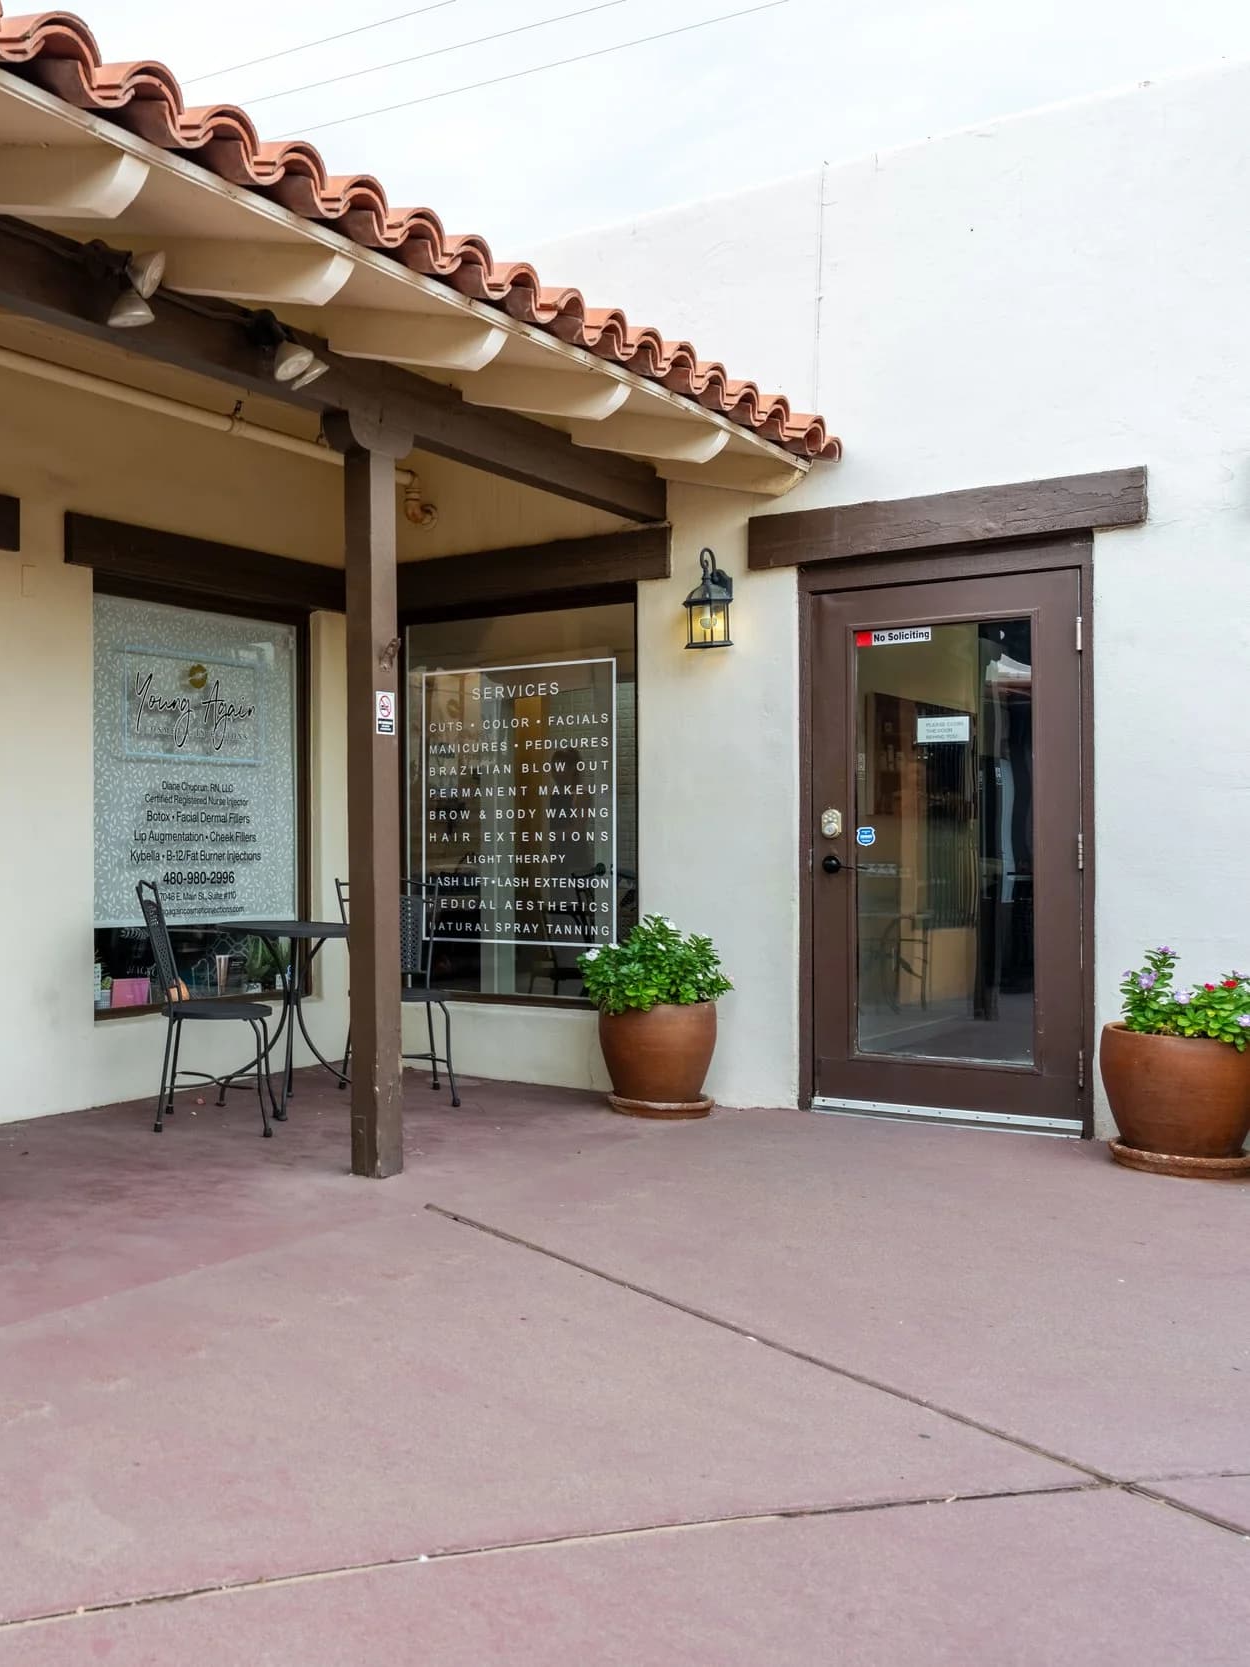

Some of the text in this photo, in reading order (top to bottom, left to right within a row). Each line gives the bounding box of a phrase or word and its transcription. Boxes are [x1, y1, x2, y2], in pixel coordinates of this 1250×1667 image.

[874, 630, 930, 642] No Soliciting
[472, 682, 559, 700] SERVICES
[135, 671, 255, 751] Young Again
[429, 713, 609, 733] CUTS COLOR FACIALS
[429, 737, 609, 755] MANICURES PEDICURES
[429, 760, 609, 776] BRAZILIAN BLOW OUT
[429, 784, 609, 798] PERMANENT MAKEUP
[146, 810, 251, 824] Botox Facial Dermal Fillers
[429, 807, 609, 821] BROW & BODY WAXING
[134, 830, 257, 844] Lip Augmentation Cheek Fillers
[429, 831, 609, 842] HAIR EXTENSIONS
[130, 849, 262, 864] Kybella B-12/Fat Burner Injections
[466, 854, 566, 864] LIGHT THERAPY
[163, 871, 235, 885] 480-980-2996
[534, 878, 609, 889] EXTENSION
[504, 900, 609, 912] AESTHETICS
[495, 923, 539, 935] SPRAY
[546, 924, 609, 937] TANNING
